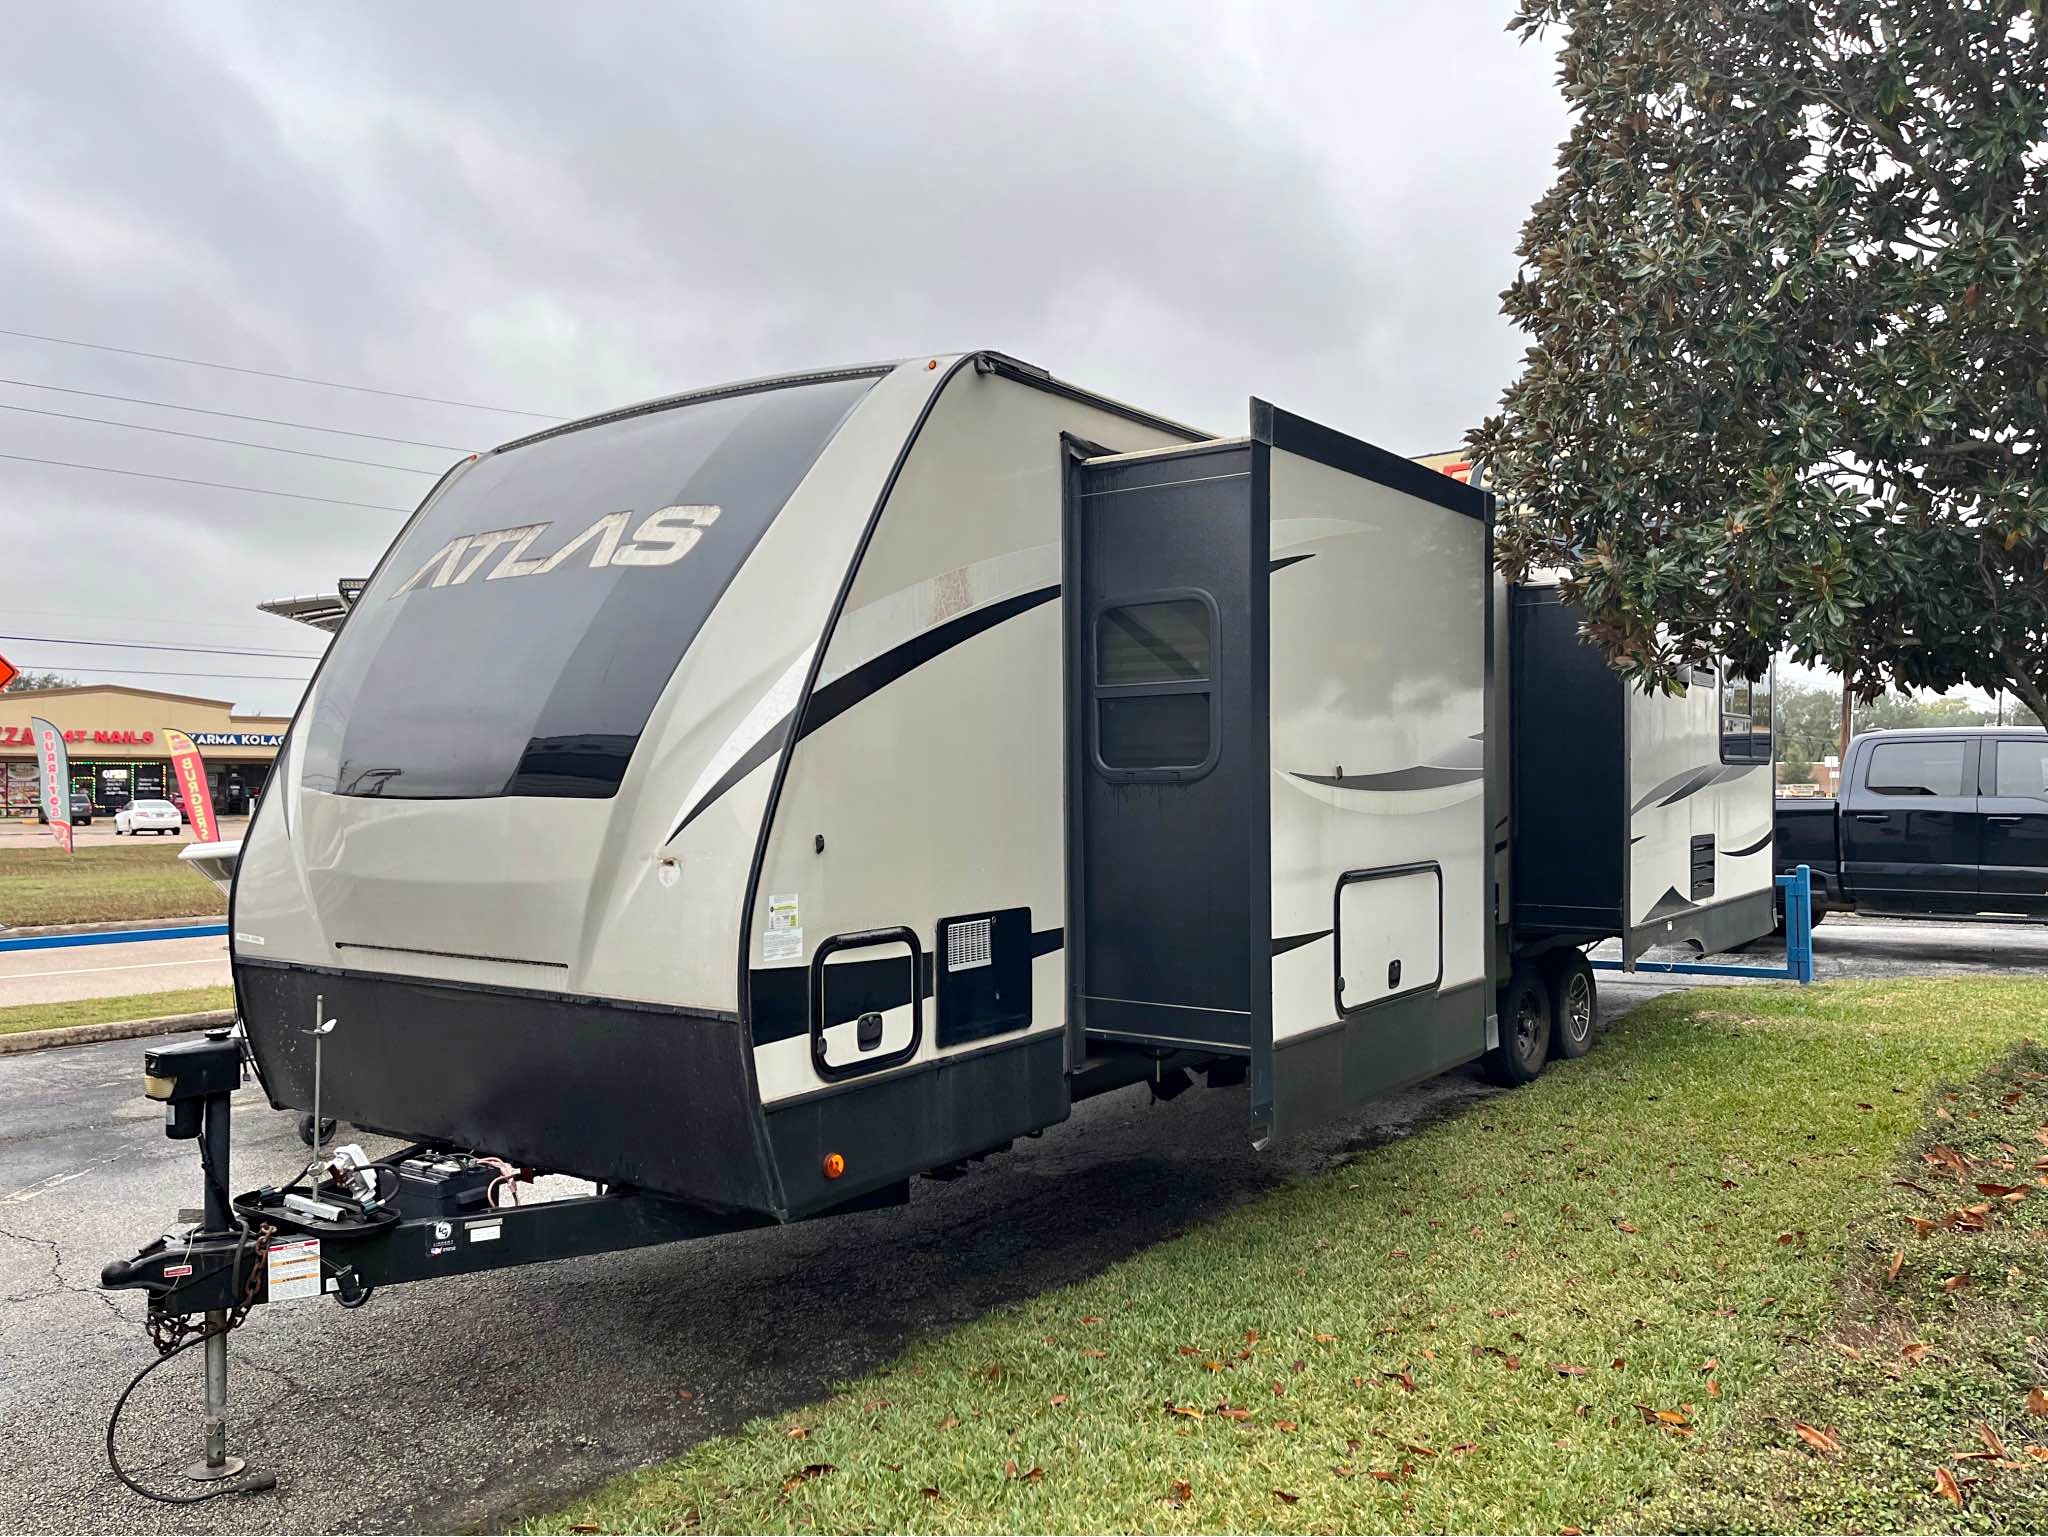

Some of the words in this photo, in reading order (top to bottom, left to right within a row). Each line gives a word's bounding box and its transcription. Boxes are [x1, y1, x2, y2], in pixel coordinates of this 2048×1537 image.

[387, 504, 722, 601] ATLAS
[0, 726, 35, 747] ZA
[94, 731, 154, 745] NAILS
